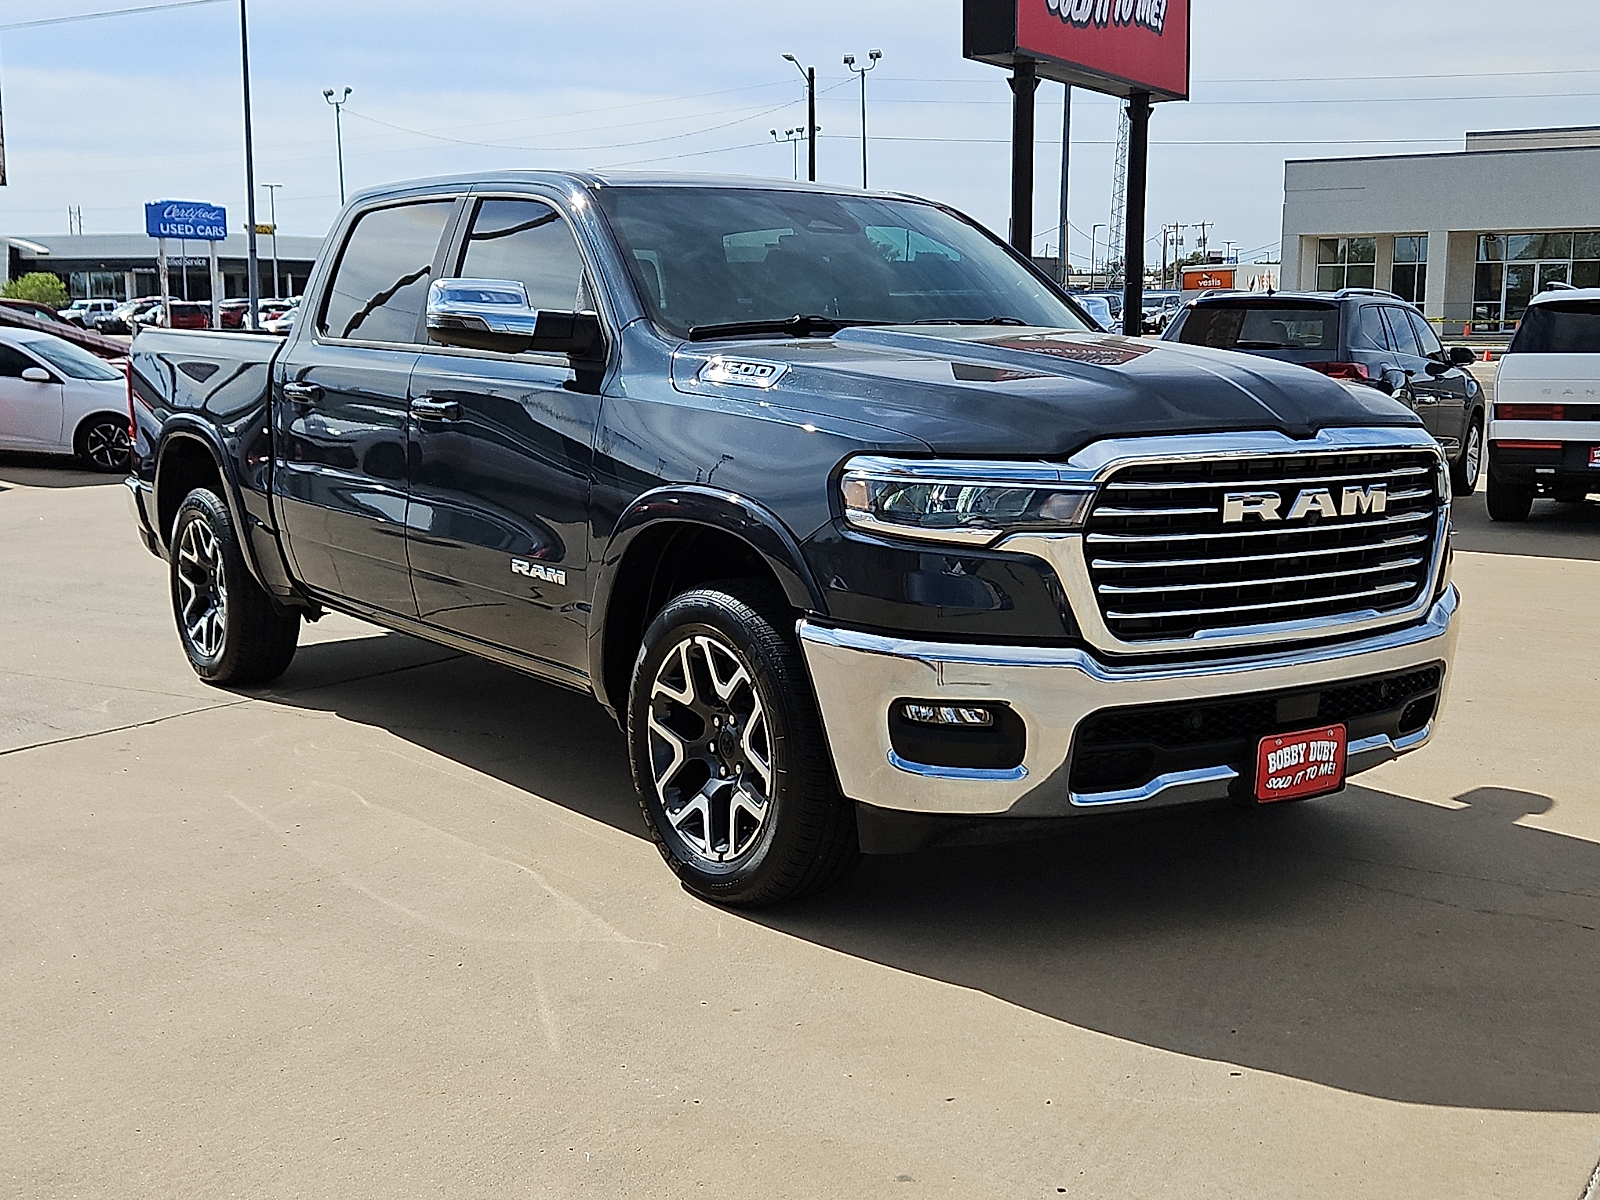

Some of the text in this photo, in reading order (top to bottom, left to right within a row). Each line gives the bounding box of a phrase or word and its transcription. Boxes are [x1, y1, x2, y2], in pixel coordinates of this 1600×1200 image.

[163, 204, 222, 223] Certified
[160, 222, 226, 237] USED CARS
[184, 257, 207, 266] Service
[1198, 277, 1221, 287] vestis
[1223, 483, 1388, 524] RAM
[511, 558, 566, 586] RAM
[1267, 741, 1338, 774] BOBBY DUBY
[1265, 761, 1337, 789] SOLD IT TO ME!
